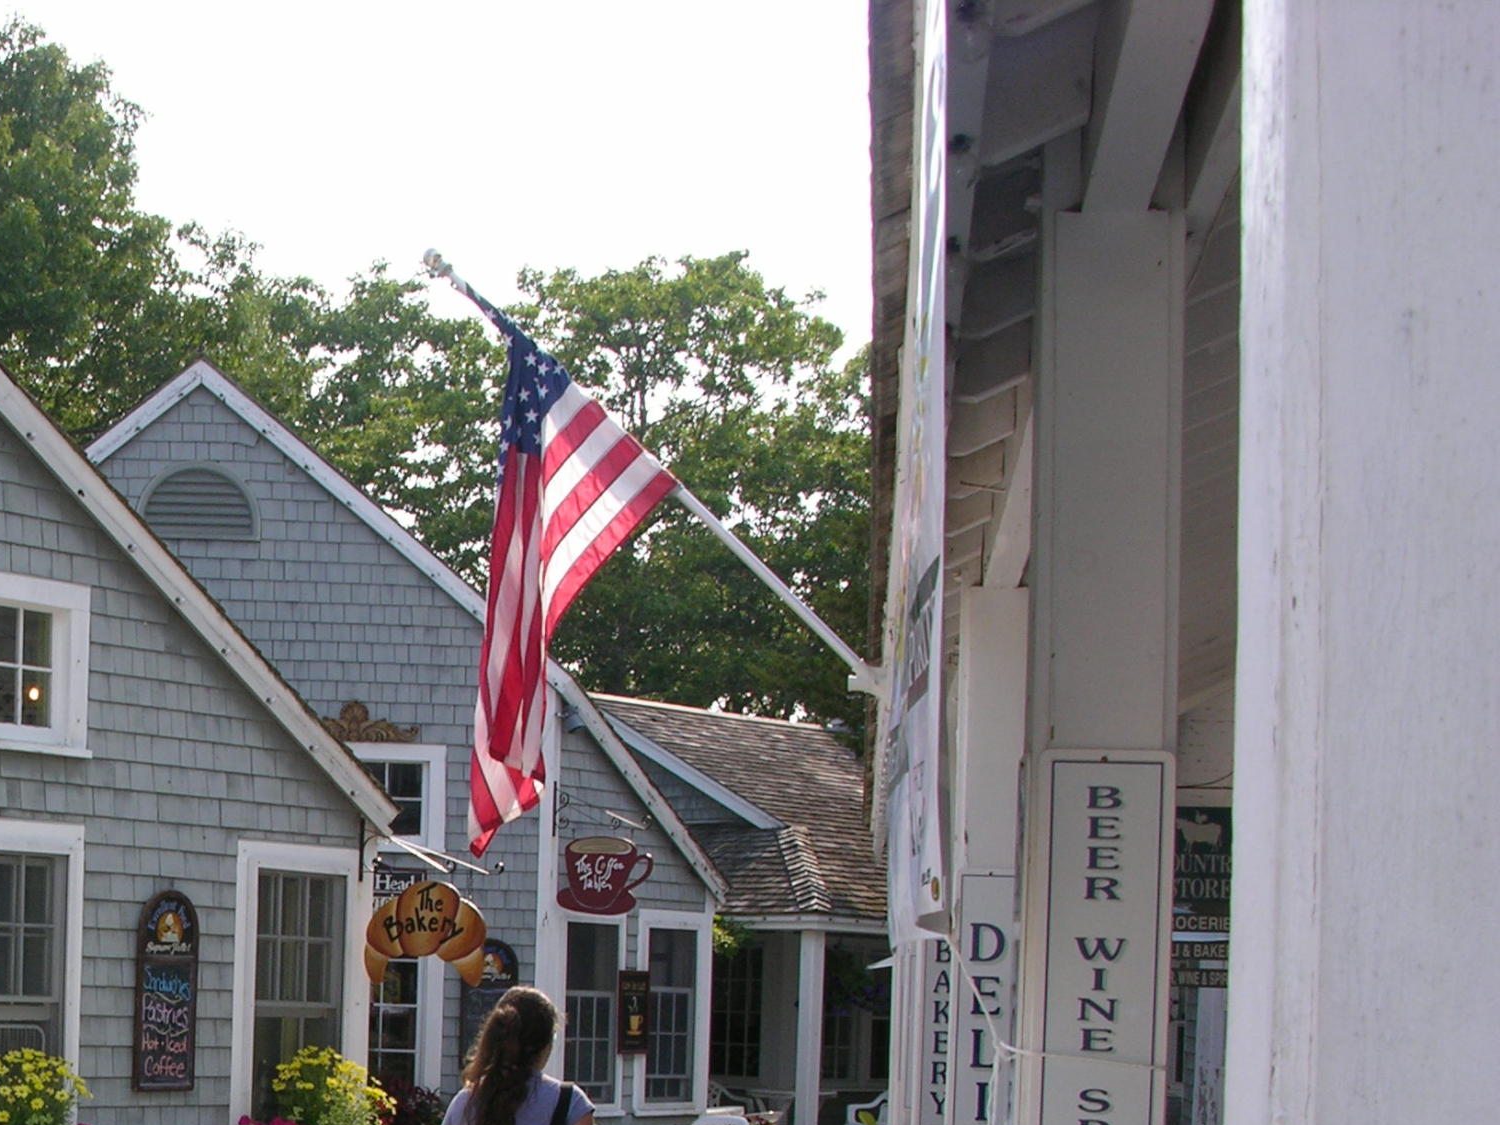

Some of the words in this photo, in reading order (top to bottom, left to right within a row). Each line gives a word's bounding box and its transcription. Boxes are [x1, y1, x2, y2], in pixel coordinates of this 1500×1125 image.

[1083, 785, 1123, 900] BEER
[1173, 853, 1231, 873] OUNTR
[418, 882, 443, 912] The
[384, 908, 464, 944] Bakery
[1172, 916, 1231, 930] OCERIE
[1194, 944, 1229, 957] BAKE
[1209, 971, 1228, 986] SPIR
[1075, 936, 1126, 1053] WINE
[142, 992, 189, 1029] Pastries
[969, 921, 1005, 1121] DELI
[142, 1033, 160, 1051] Hot
[931, 940, 951, 1115] BAKERY
[145, 1056, 186, 1079] Coffee
